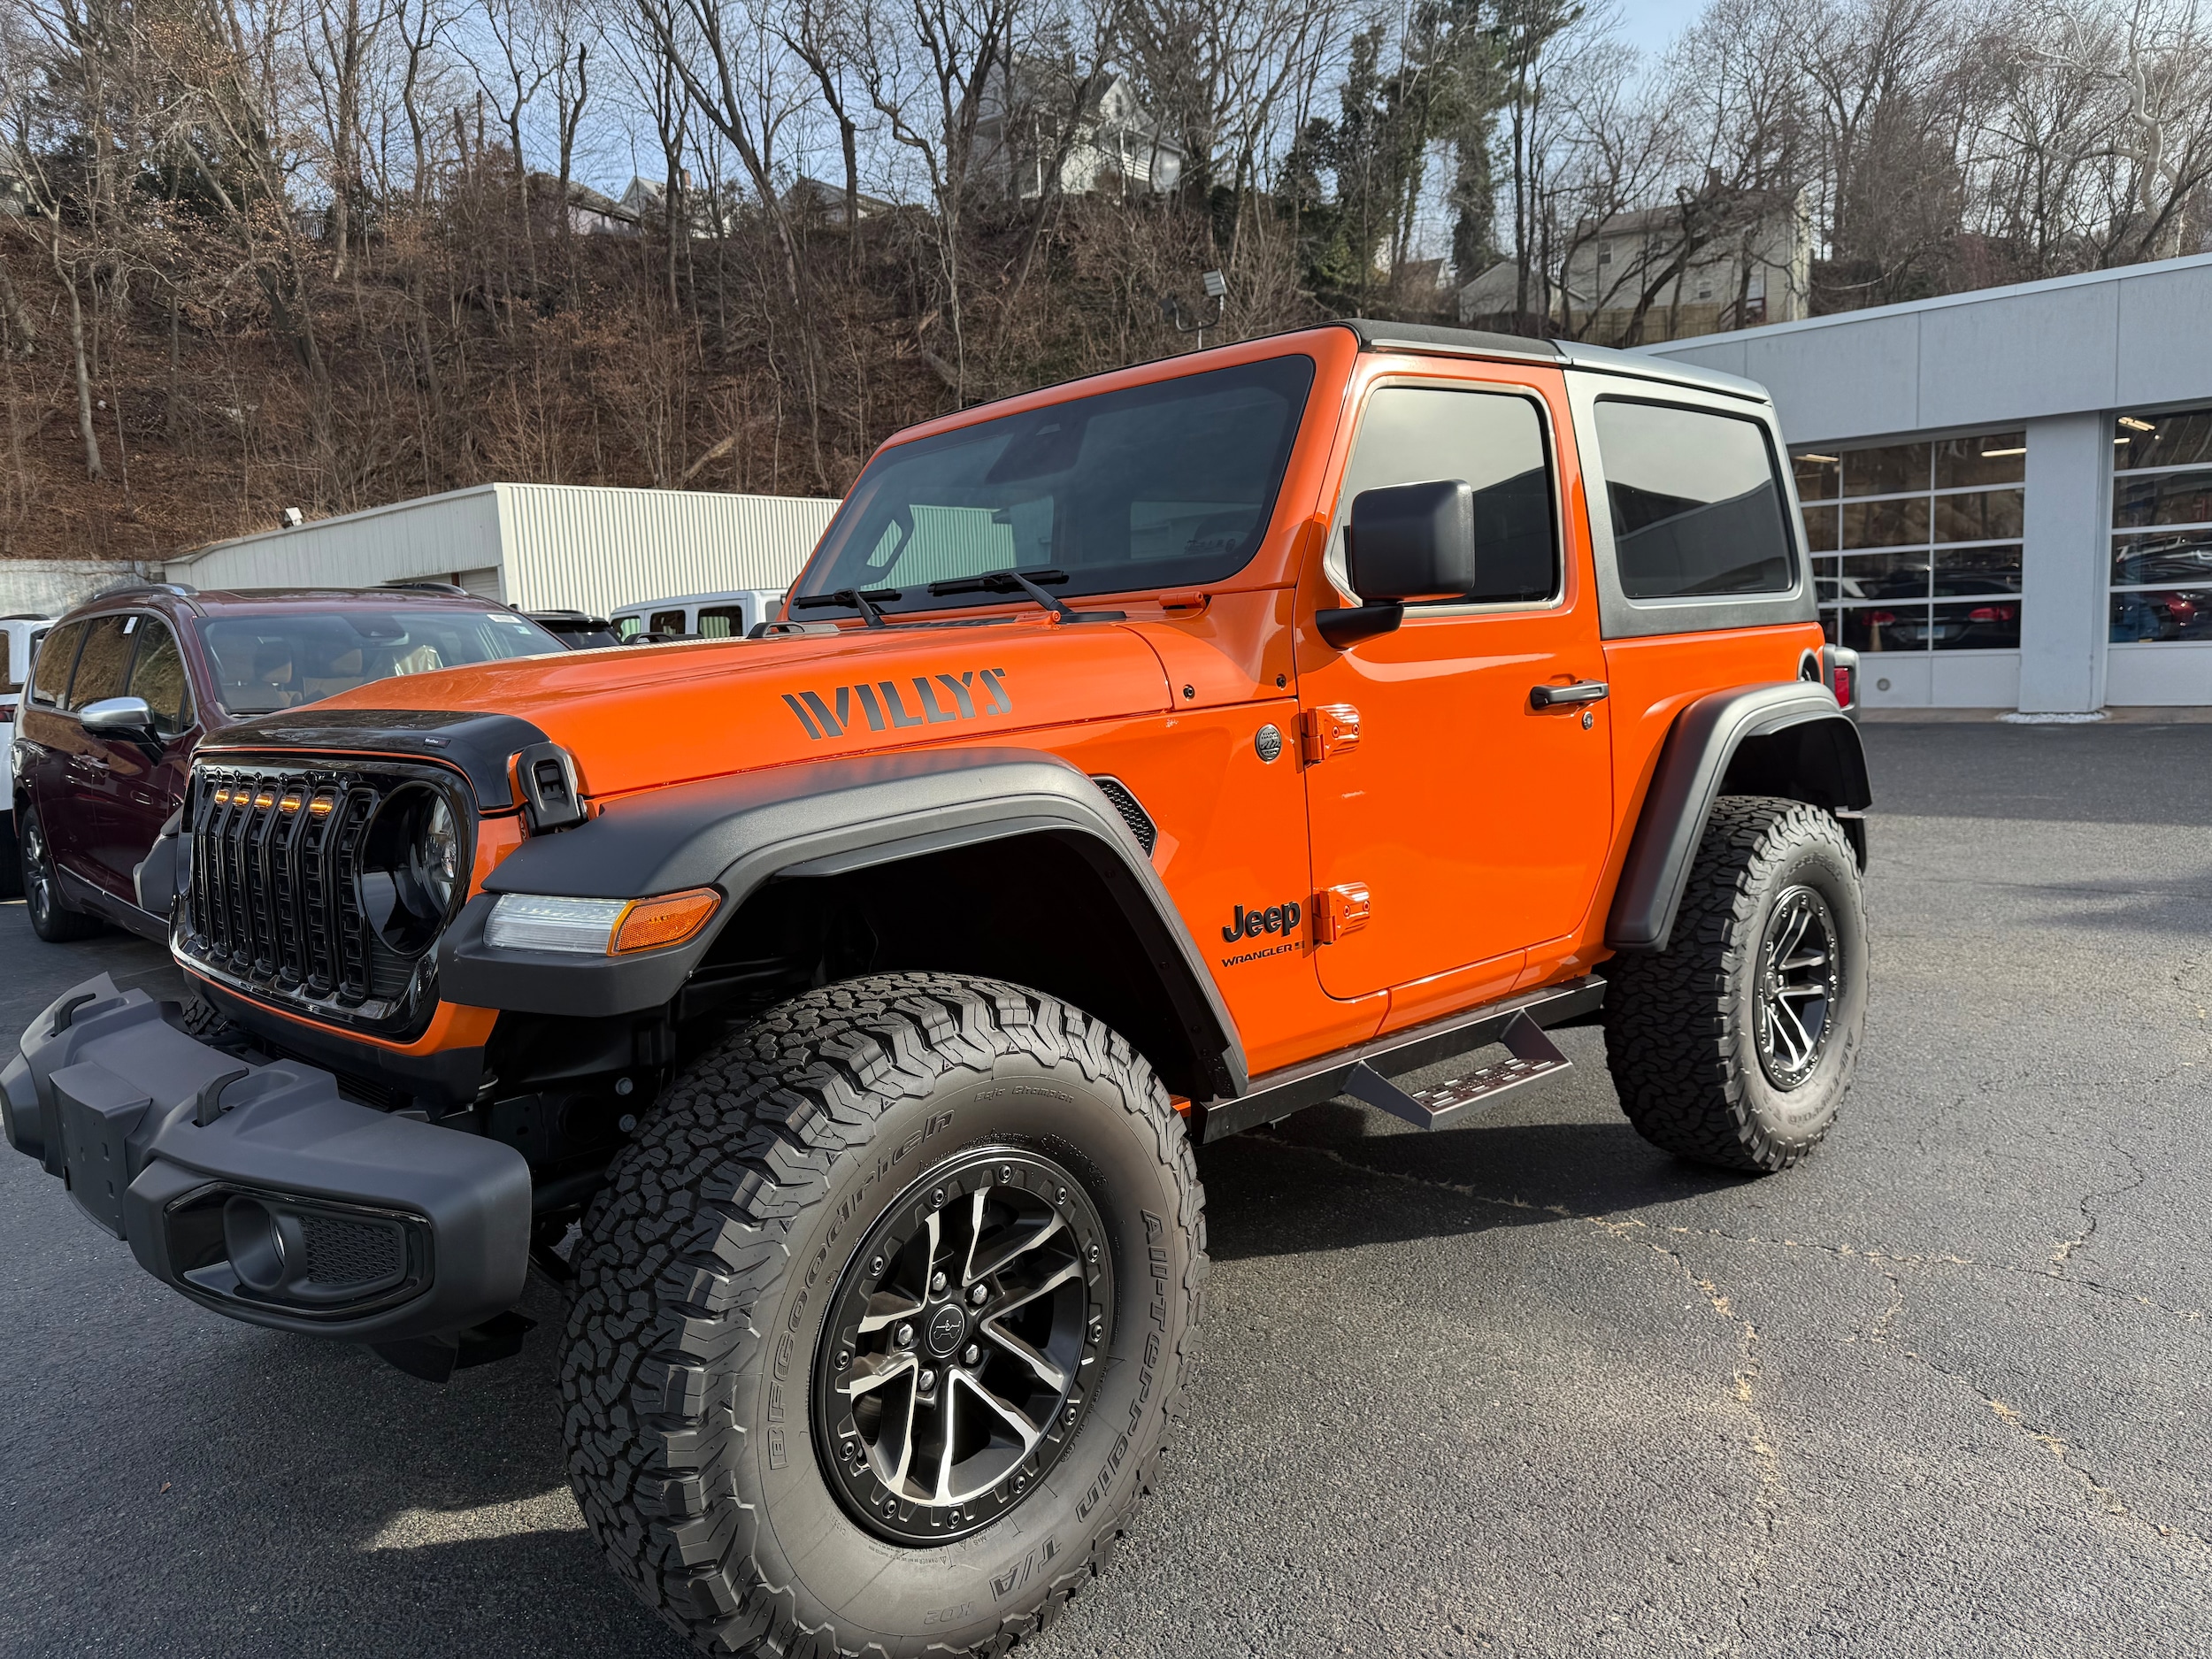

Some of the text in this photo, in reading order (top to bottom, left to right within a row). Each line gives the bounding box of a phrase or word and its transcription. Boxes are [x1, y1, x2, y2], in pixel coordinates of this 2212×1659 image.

[780, 668, 1012, 740] WILLYS
[1222, 901, 1301, 943] Jeep
[1221, 943, 1293, 967] WRANGLER
[766, 1108, 956, 1471] BFGoodrich
